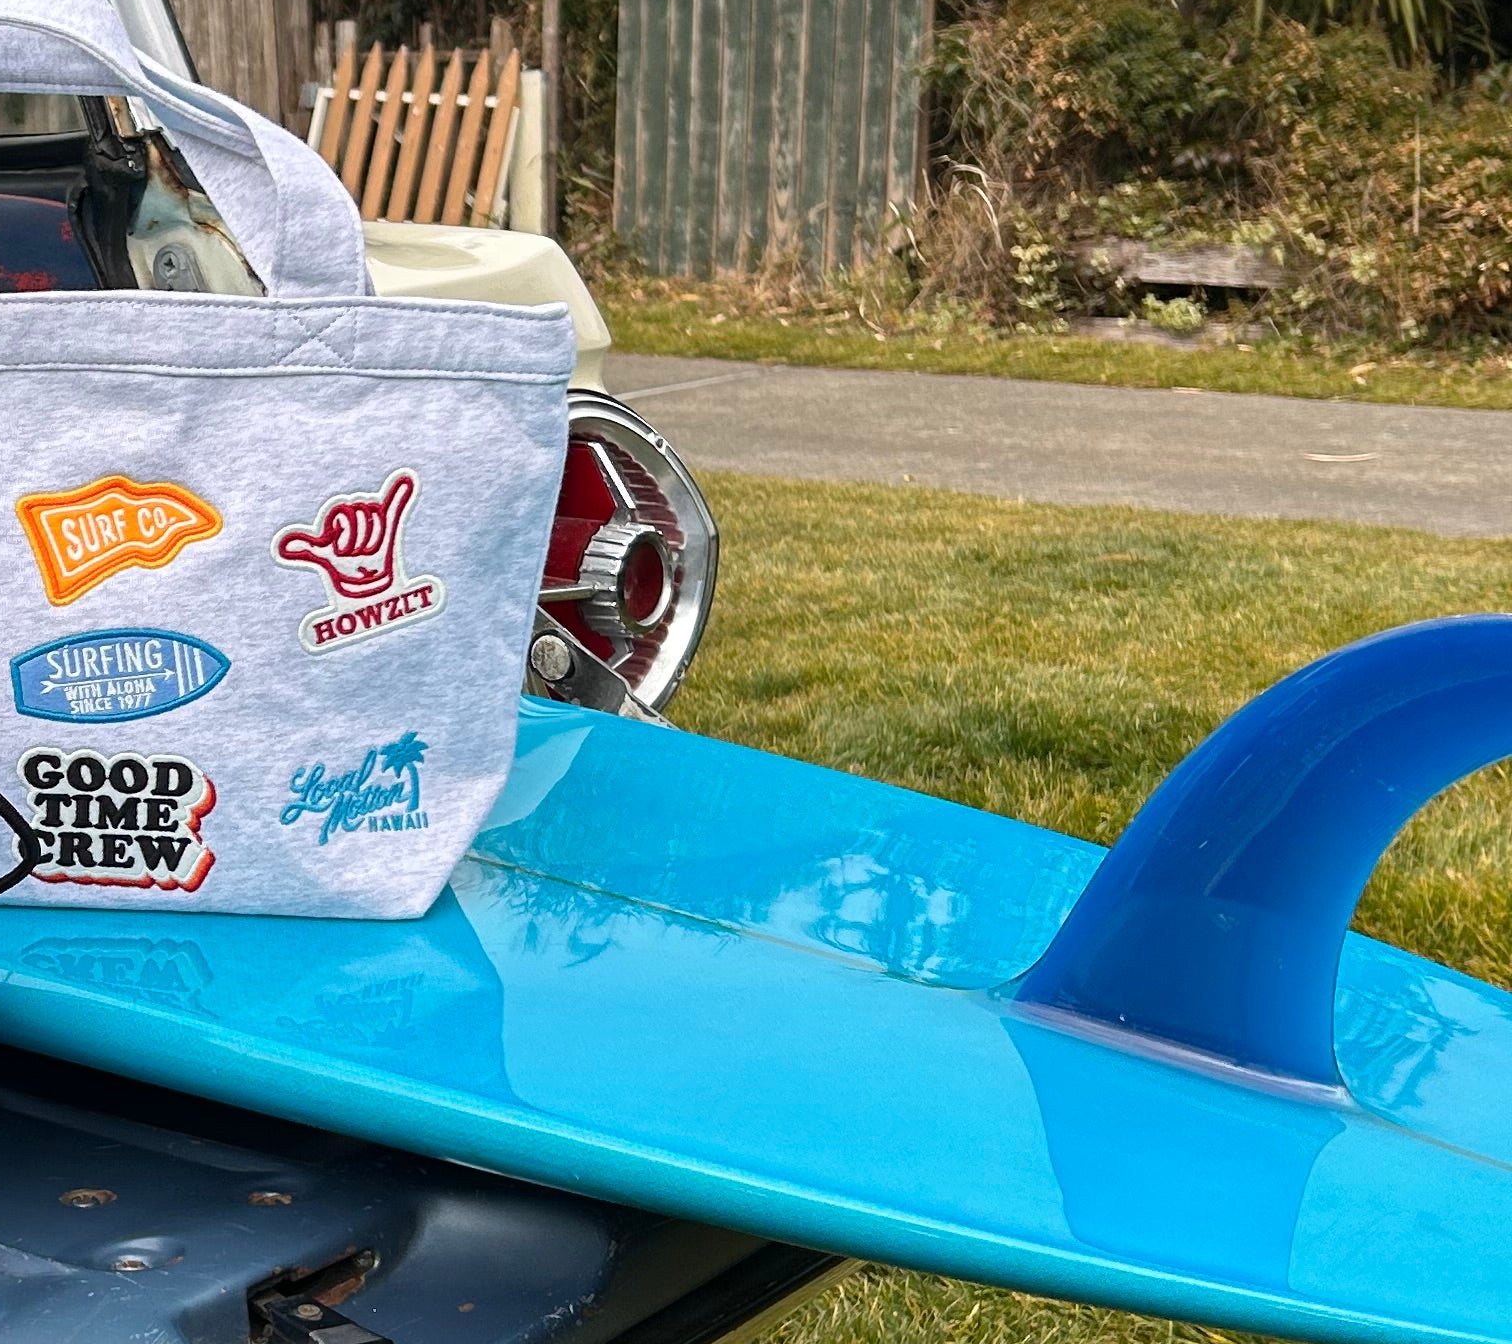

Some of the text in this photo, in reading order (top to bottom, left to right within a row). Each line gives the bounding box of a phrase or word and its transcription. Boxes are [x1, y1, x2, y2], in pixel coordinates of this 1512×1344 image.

[62, 509, 126, 561] SURF
[313, 586, 433, 644] HOWZIT
[46, 640, 162, 679] SURFING
[64, 677, 157, 701] WITH ALOHA
[70, 692, 152, 715] SINCE 1977
[24, 754, 193, 797] GOOD
[280, 747, 377, 825] Local
[34, 793, 178, 831] TIME
[318, 781, 409, 846] Motion
[368, 811, 429, 833] HAWAII
